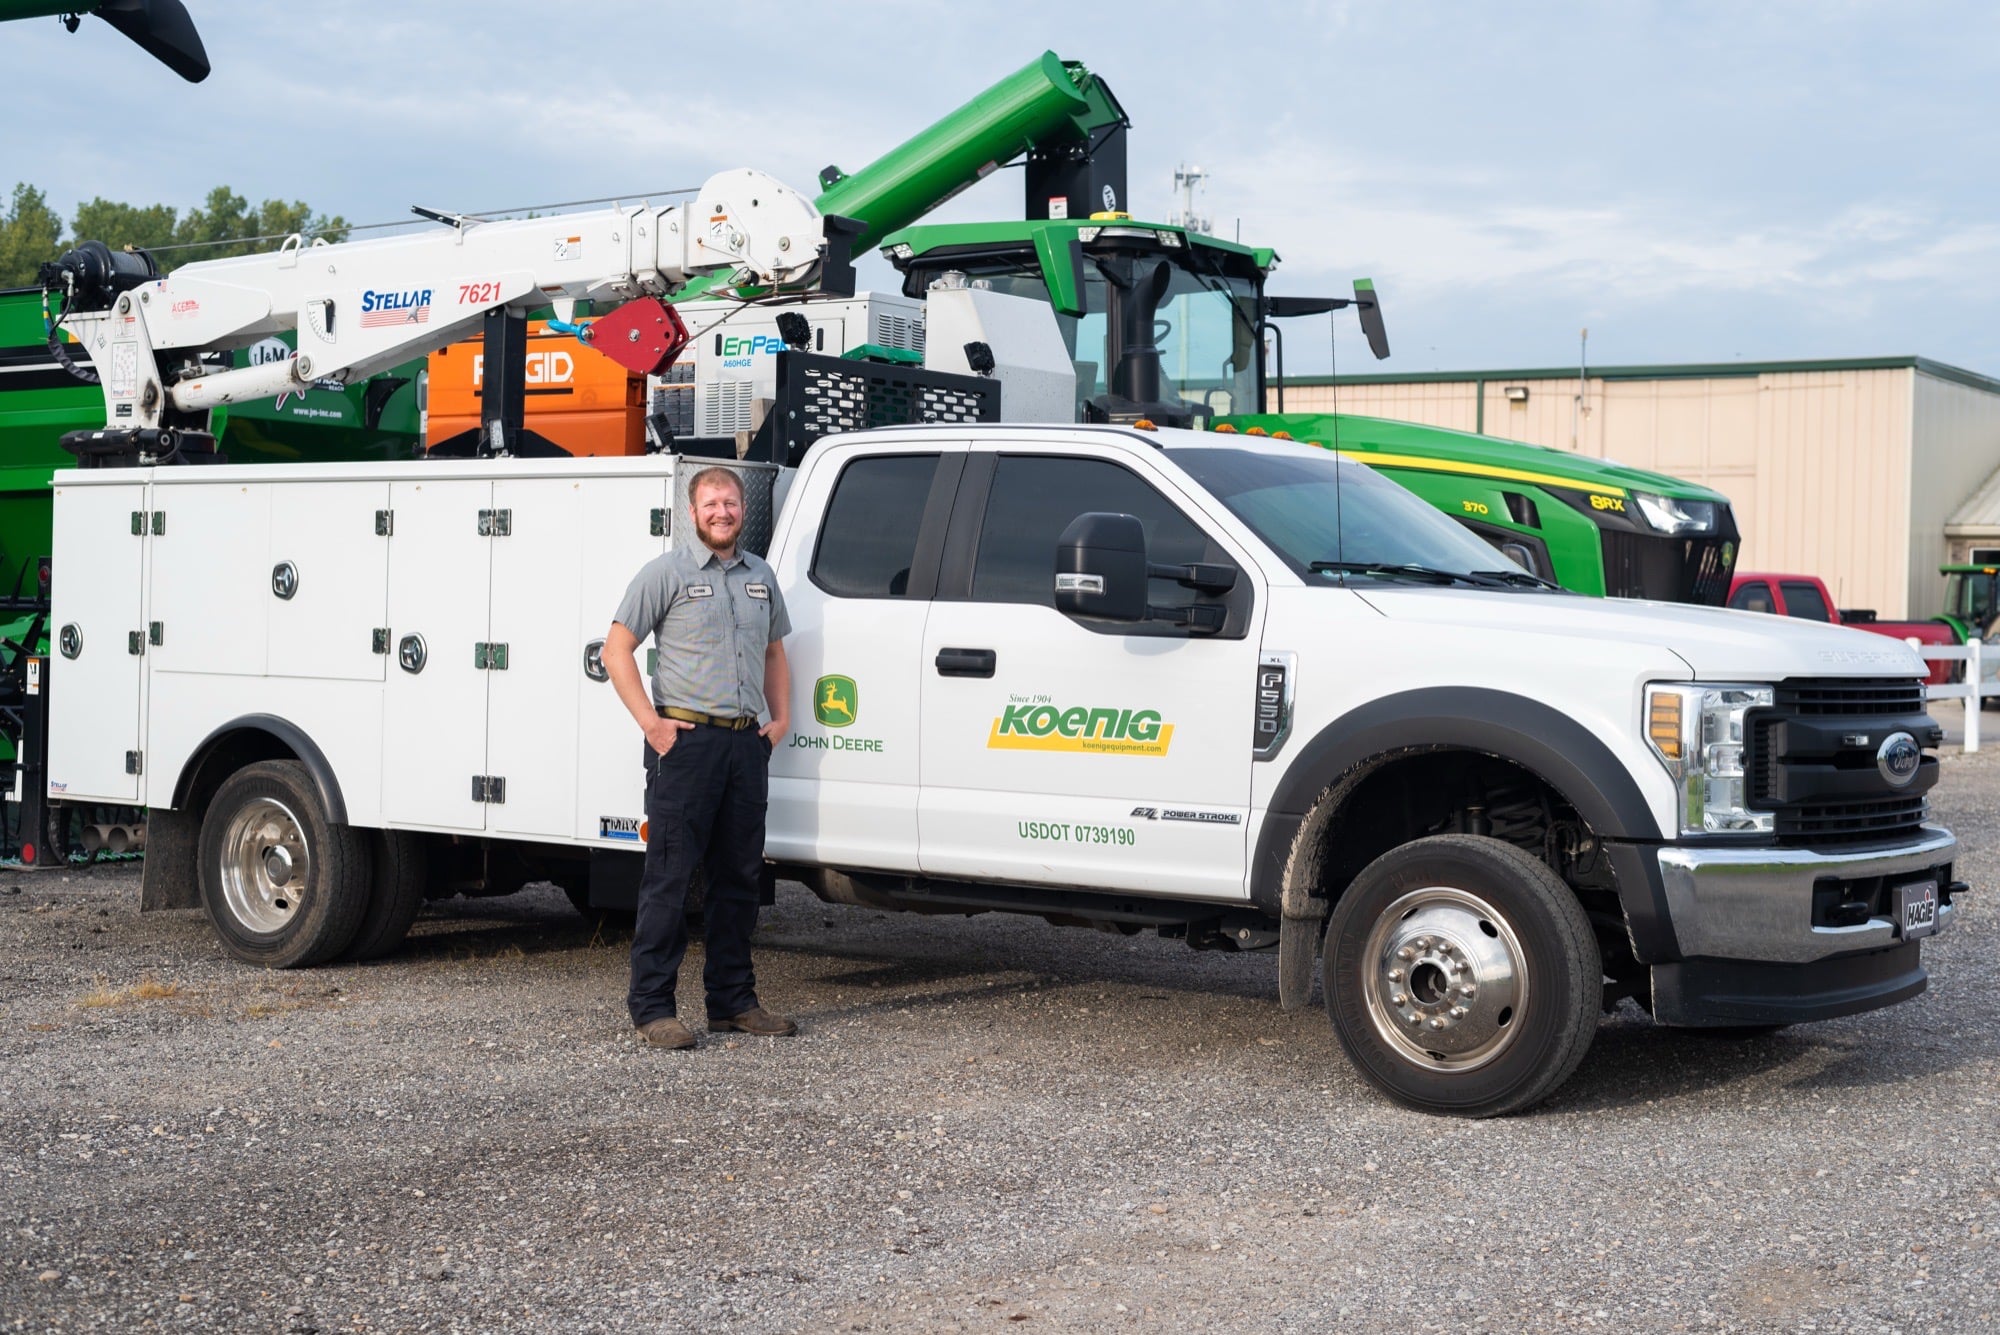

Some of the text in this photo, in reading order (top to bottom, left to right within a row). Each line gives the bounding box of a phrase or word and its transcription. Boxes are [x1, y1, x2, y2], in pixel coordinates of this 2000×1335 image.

[362, 289, 432, 312] STELLAR
[458, 282, 501, 304] 7621
[254, 346, 285, 366] J&M
[1463, 501, 1488, 514] 370
[1590, 495, 1625, 512] 8RX
[1009, 693, 1030, 703] Since
[789, 732, 883, 752] JOHN DEERE
[1083, 741, 1162, 754] koenigequipment.com
[1163, 809, 1197, 819] POWER
[1198, 812, 1238, 822] STROKE
[601, 817, 638, 836] TMAX
[1018, 821, 1135, 846] USDOT 0739190
